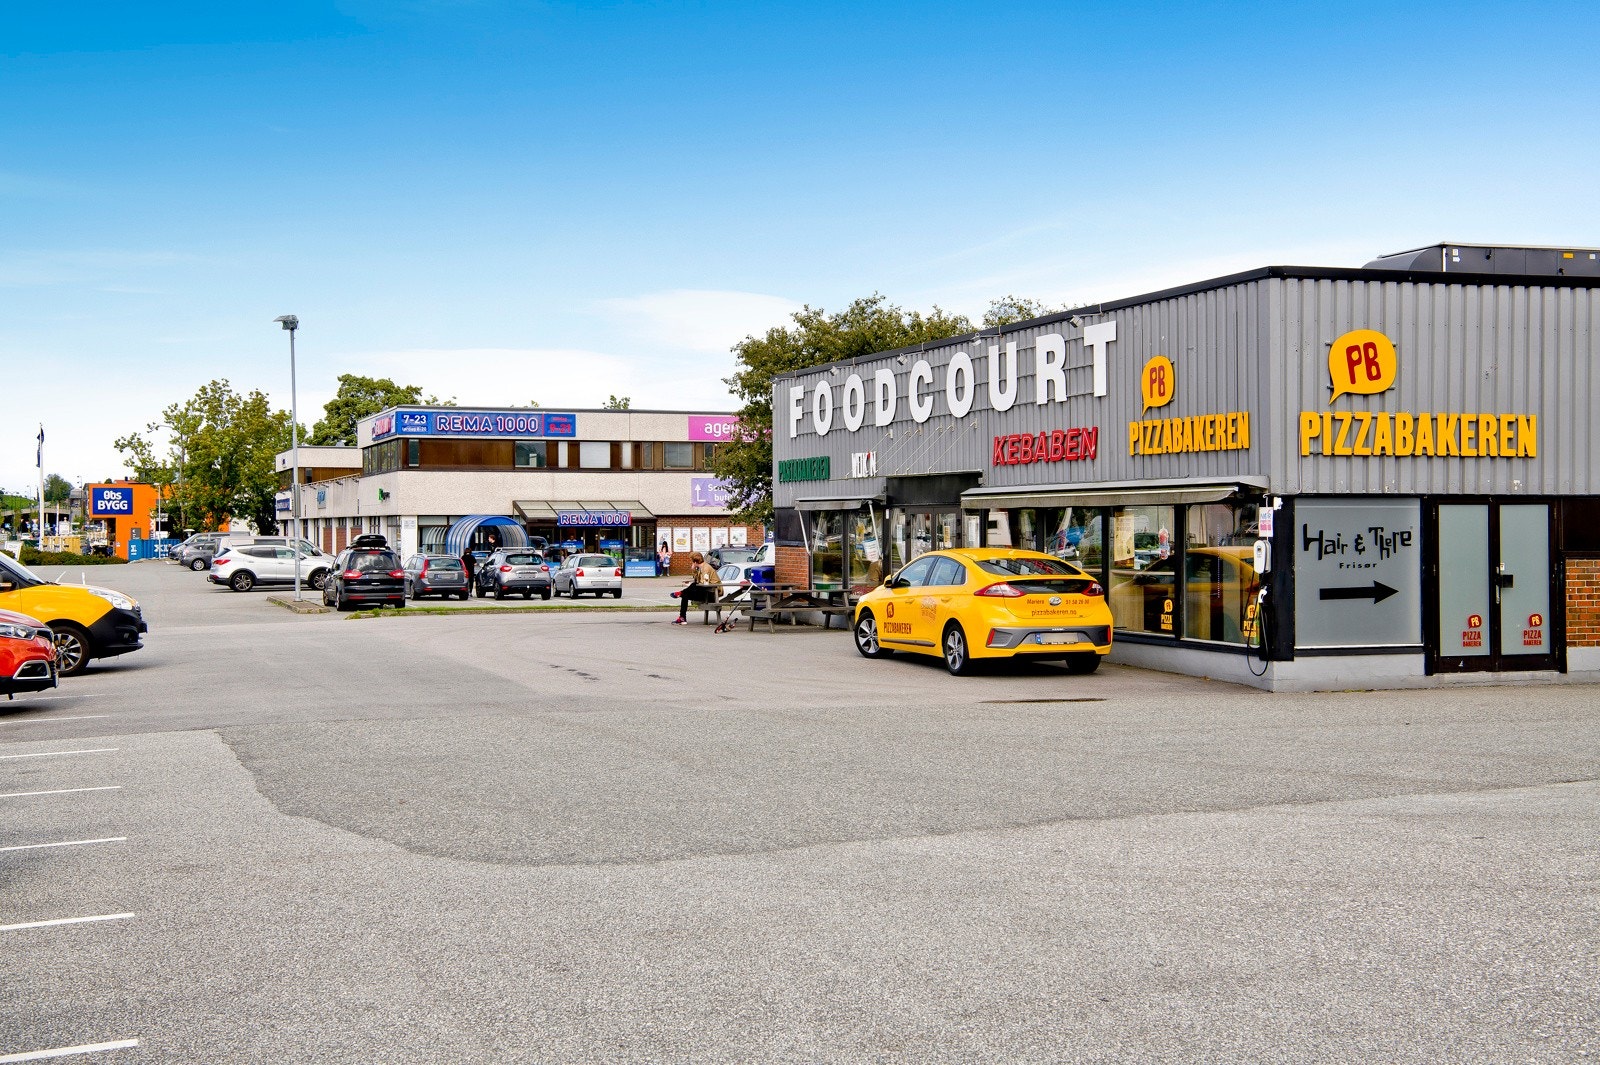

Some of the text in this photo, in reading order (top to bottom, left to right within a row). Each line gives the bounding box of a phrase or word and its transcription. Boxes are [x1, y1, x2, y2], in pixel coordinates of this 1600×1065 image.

[1345, 341, 1382, 385] PB
[1149, 365, 1166, 398] PB
[403, 415, 426, 424] 7-23
[437, 415, 538, 432] REMA 1000
[1128, 411, 1250, 456] PIZZABAKEREN
[1300, 411, 1537, 458] PIZZABAKEREN
[992, 426, 1099, 467] KEBABEN
[97, 500, 128, 510] BYGG
[560, 513, 629, 525] REMA 1000
[1303, 523, 1412, 560] Hair & There
[1471, 616, 1480, 626] PB
[1531, 615, 1541, 625] PB
[1462, 631, 1481, 640] PIZZA
[1523, 630, 1542, 639] PIZZA
